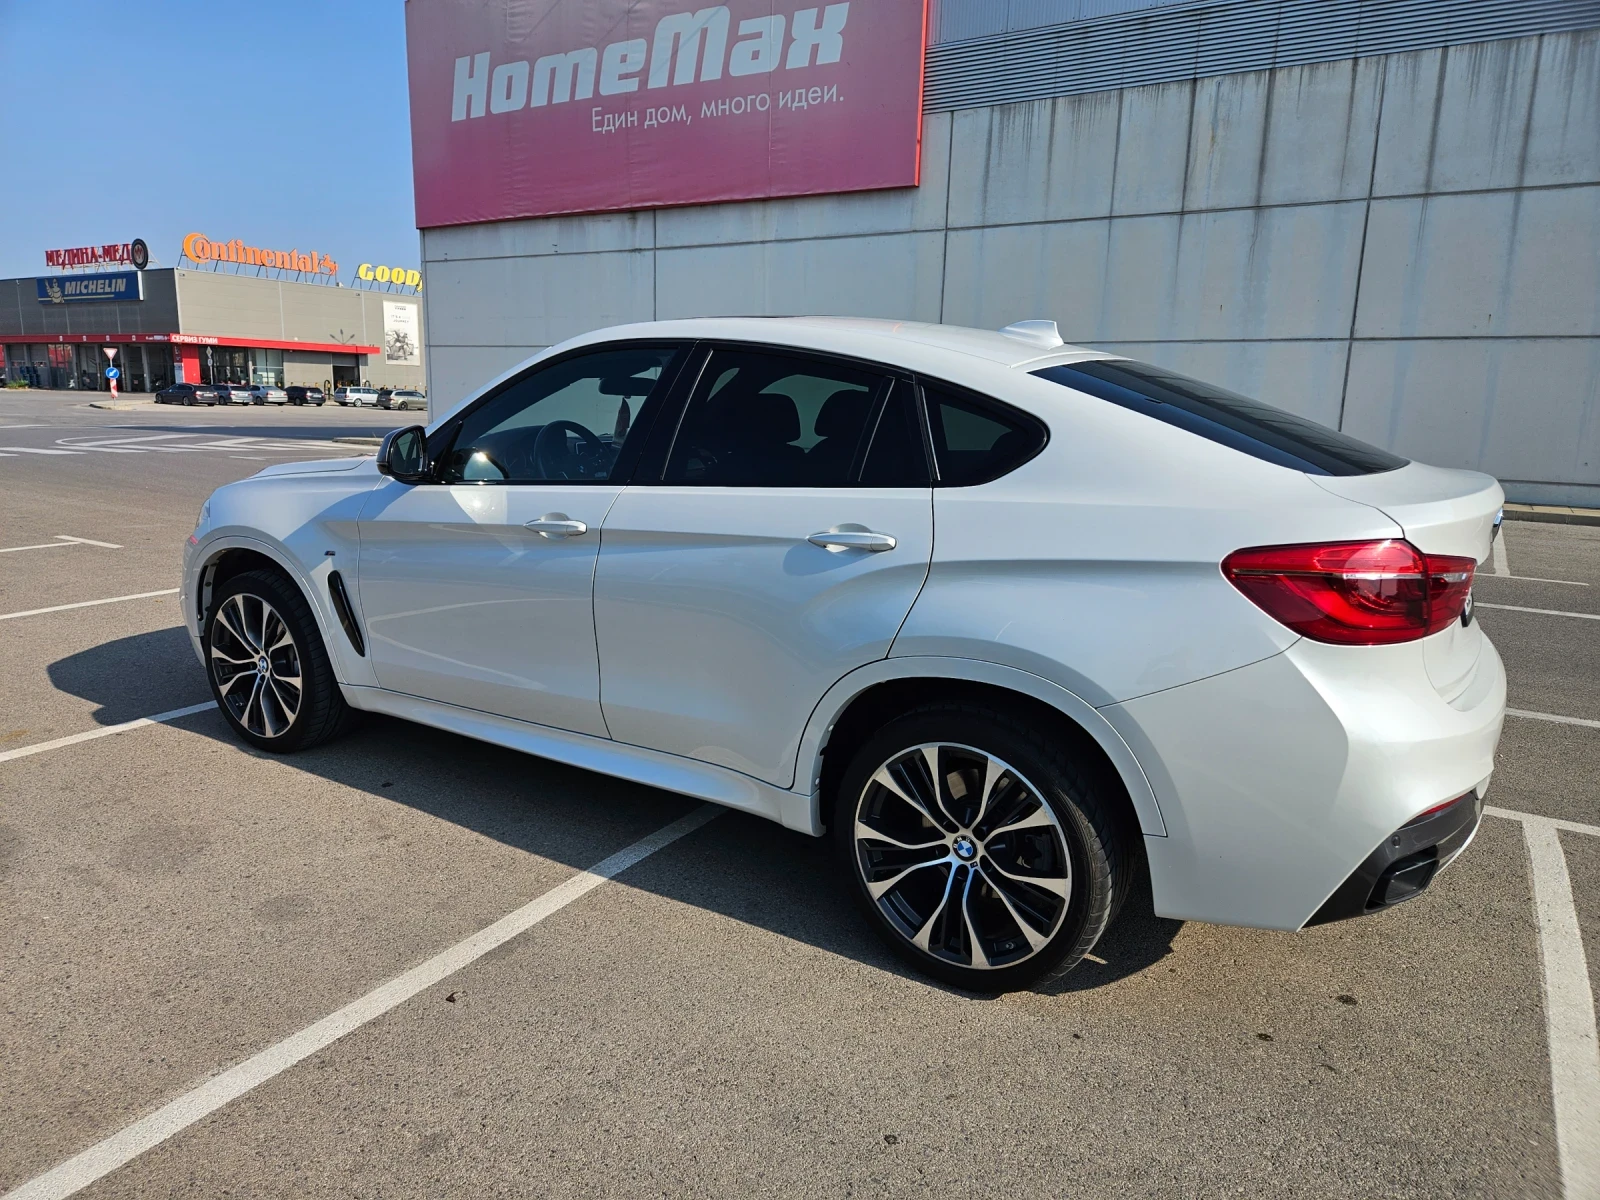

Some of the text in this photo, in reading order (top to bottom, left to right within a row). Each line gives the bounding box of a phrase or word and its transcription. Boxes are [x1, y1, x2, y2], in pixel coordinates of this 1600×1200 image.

[452, 2, 850, 122] HomeMax
[591, 84, 845, 134] Един дом, много идеи.
[183, 232, 321, 273] Continental
[64, 278, 127, 295] MICHELIN
[171, 335, 198, 344] СЕРВИЗ
[199, 336, 219, 344] ГУМИ
